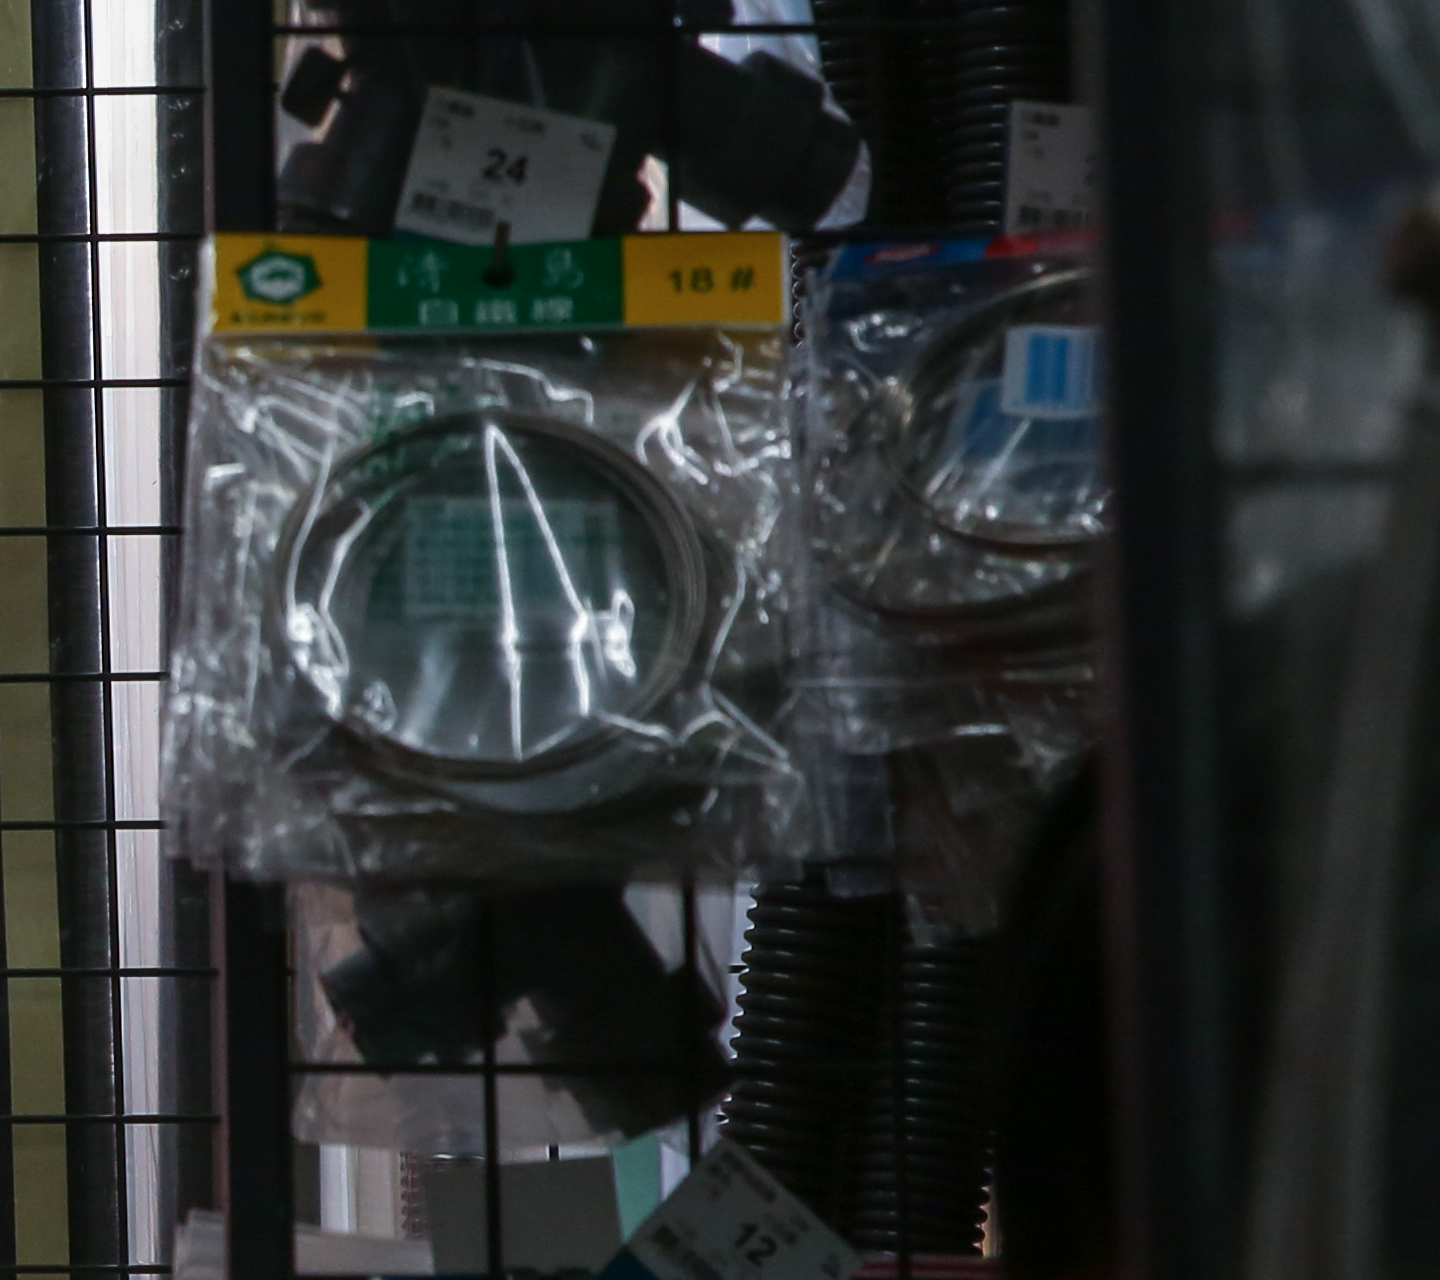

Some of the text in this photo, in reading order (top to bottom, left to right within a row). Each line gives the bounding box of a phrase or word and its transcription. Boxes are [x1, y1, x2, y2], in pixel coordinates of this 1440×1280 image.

[482, 149, 529, 185] 24
[666, 266, 757, 295] 18 #
[734, 1223, 778, 1268] 12
